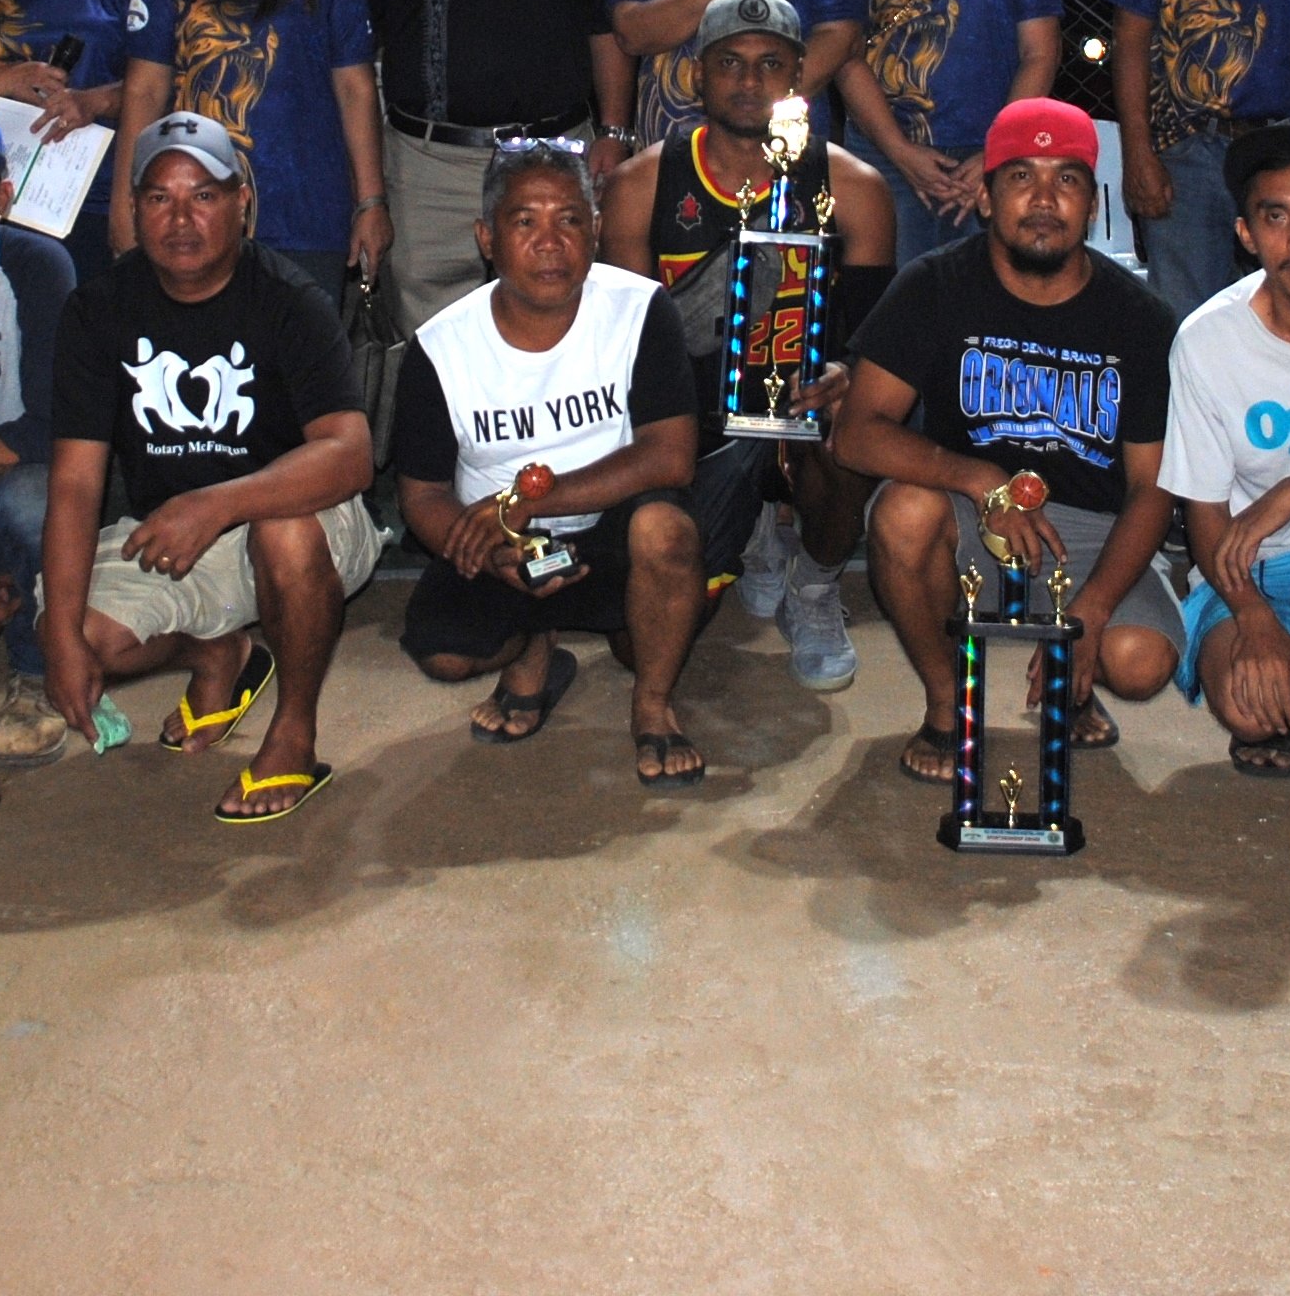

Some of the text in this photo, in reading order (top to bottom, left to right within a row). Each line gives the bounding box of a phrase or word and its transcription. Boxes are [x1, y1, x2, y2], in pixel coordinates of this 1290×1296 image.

[745, 306, 806, 366] 22
[1060, 348, 1103, 366] BRAND
[473, 382, 624, 443] NEW YORK
[146, 443, 185, 456] Rotary
